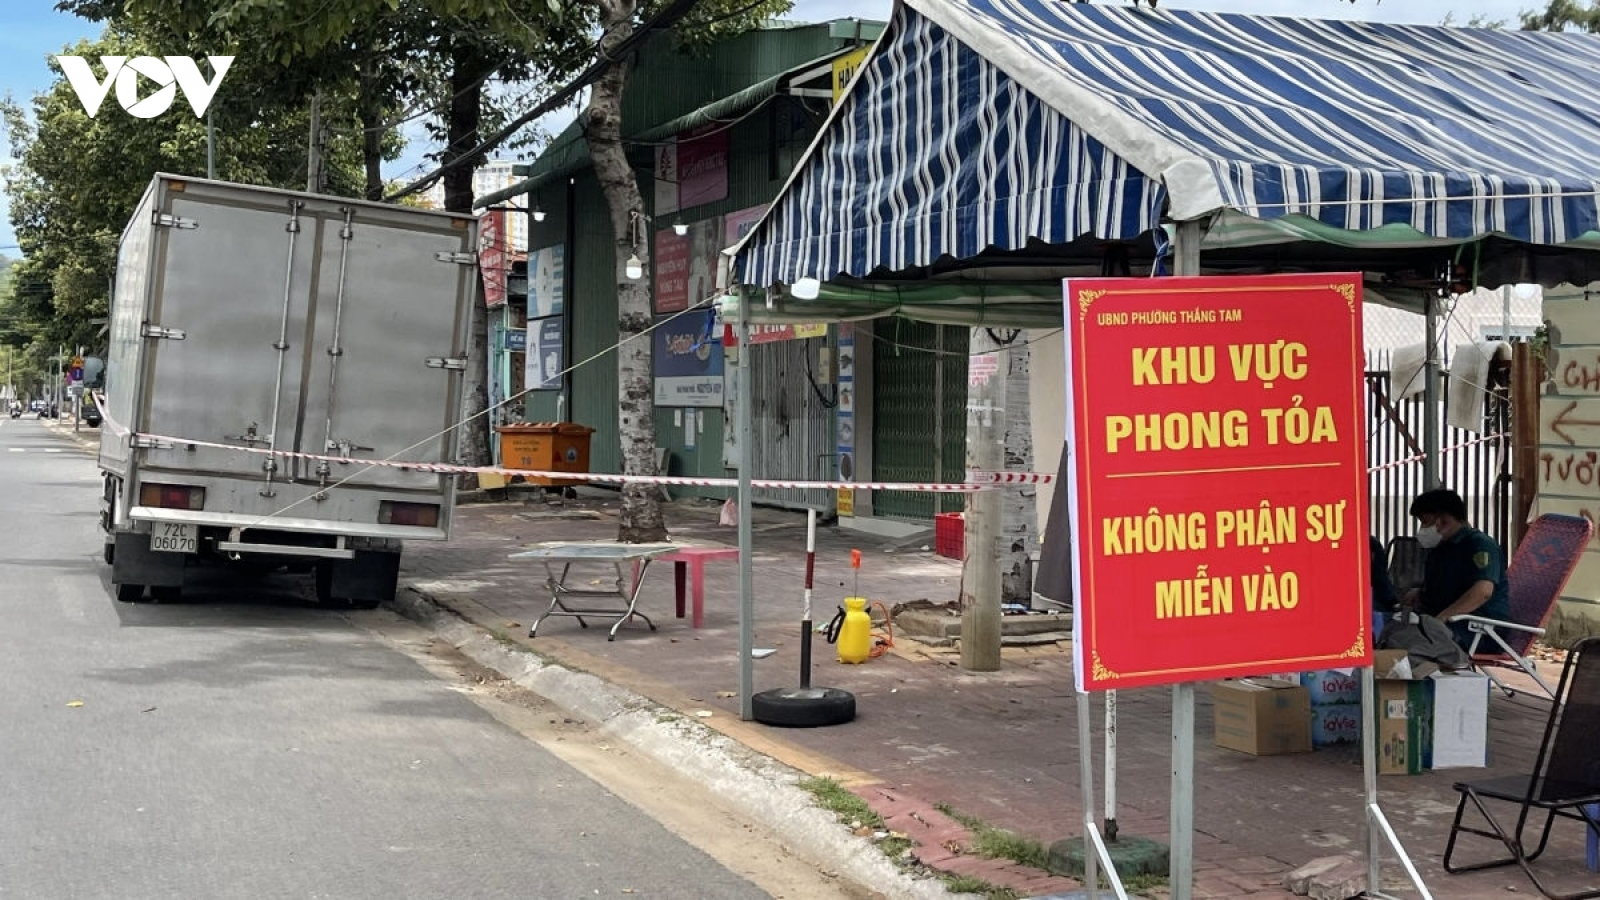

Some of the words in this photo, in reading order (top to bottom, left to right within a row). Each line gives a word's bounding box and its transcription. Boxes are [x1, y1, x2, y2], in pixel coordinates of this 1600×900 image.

[1097, 312, 1128, 326] UBND
[1131, 309, 1177, 325] PHƯỜNG
[1219, 308, 1242, 322] TAM
[1132, 345, 1215, 386] KHU
[1229, 339, 1307, 389] VỰC
[1106, 411, 1249, 453] PHONG
[1261, 395, 1338, 446] TỎA
[164, 523, 187, 536] 72C
[1103, 507, 1206, 556] KHÔNG
[1216, 500, 1297, 553] PHẬN
[1306, 499, 1346, 549] SỰ
[1155, 564, 1233, 619] MIỄN
[1241, 565, 1299, 612] VÀO
